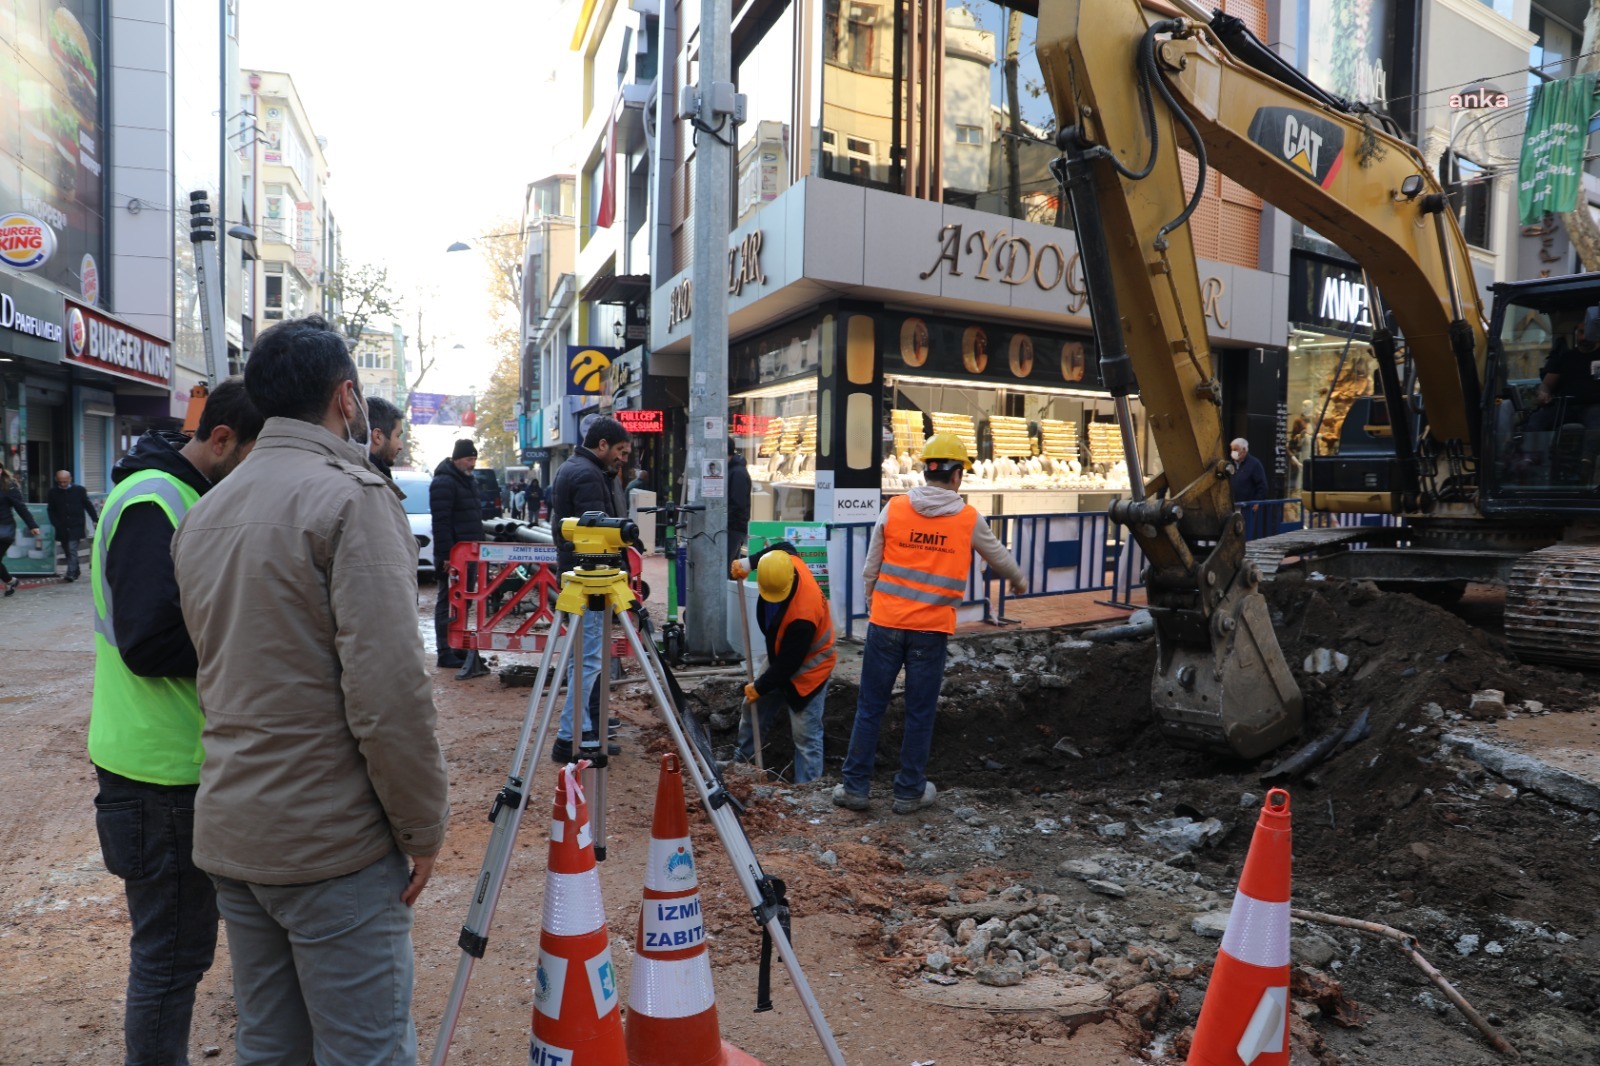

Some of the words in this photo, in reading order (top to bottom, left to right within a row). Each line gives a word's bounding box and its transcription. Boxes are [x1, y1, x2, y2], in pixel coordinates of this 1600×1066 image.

[1283, 114, 1323, 179] CAT
[15, 311, 62, 343] PARFUMEUR
[89, 318, 142, 370] BURGER
[143, 345, 171, 379] KING
[909, 529, 948, 546] İZMİT
